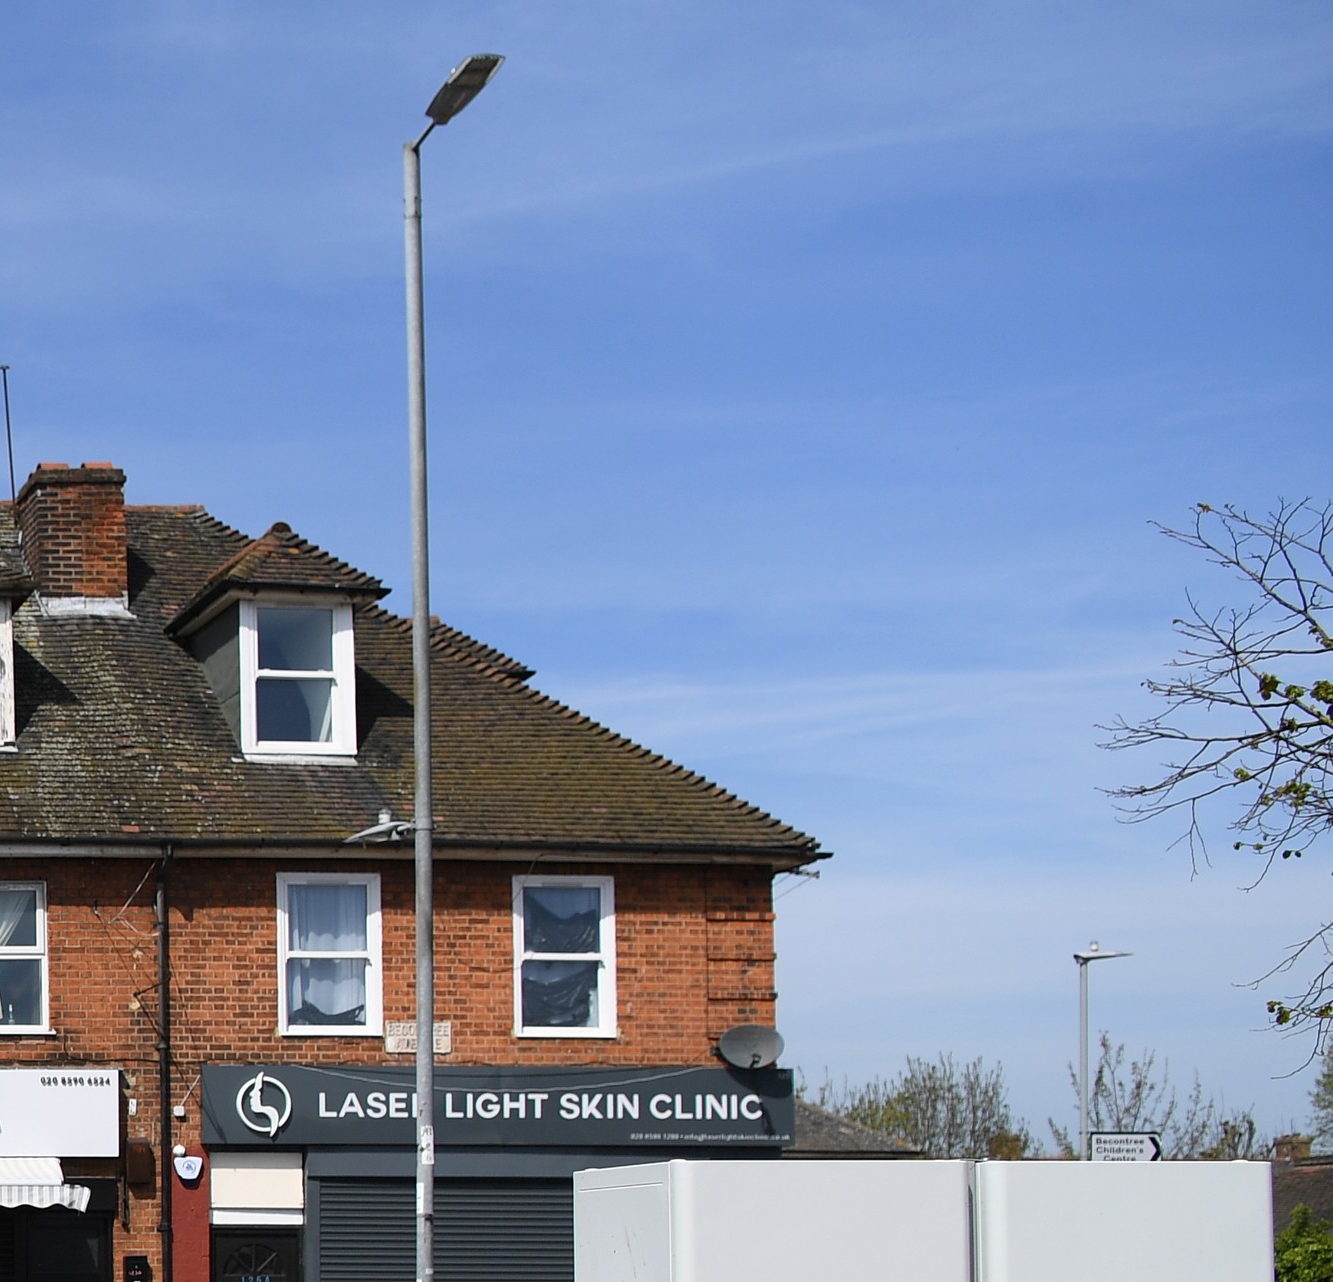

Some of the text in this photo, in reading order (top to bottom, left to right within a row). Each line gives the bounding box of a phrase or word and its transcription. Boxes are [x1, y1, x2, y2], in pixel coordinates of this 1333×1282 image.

[388, 1025, 449, 1037] BECOEE
[40, 1076, 58, 1087] 020
[319, 1092, 763, 1121] LASE LIGHT SKIN CLINIC
[1096, 1137, 1144, 1145] Becontree
[1096, 1146, 1144, 1154] Children's
